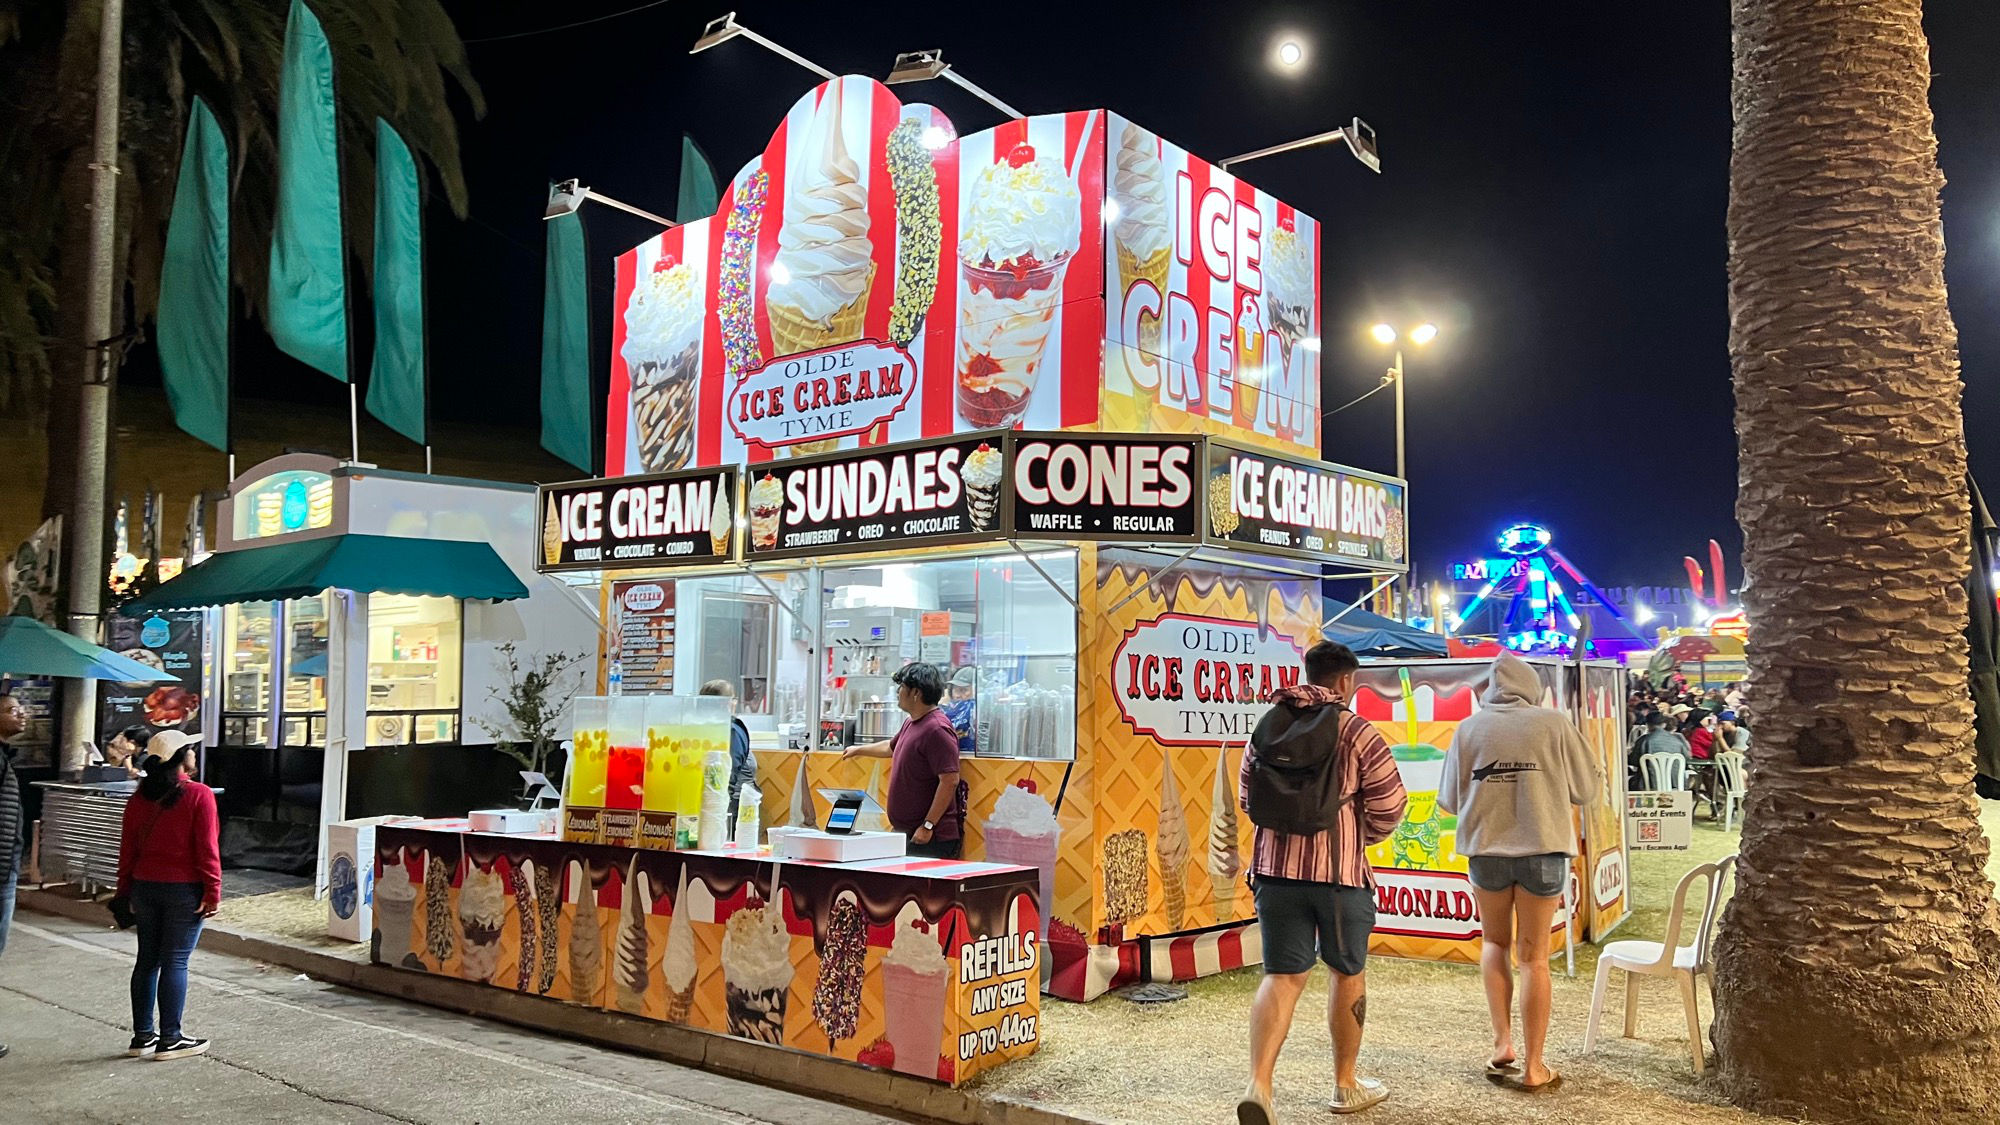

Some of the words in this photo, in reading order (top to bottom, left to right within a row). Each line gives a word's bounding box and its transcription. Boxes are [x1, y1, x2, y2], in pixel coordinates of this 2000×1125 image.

[1175, 169, 1262, 296] ICE
[785, 350, 854, 379] OLDE
[739, 386, 784, 422] ICE
[793, 363, 904, 414] CREAM
[780, 410, 853, 437] TYME
[784, 447, 961, 526] SUNDAES
[1014, 442, 1192, 508] CONES
[561, 491, 603, 543] ICE
[609, 480, 711, 539] CREAM
[1229, 455, 1265, 520] ICE
[1268, 465, 1337, 531] CREAM
[1341, 480, 1387, 539] BARS
[784, 528, 840, 548] STRAWBERRY
[858, 524, 884, 540] OREO
[903, 515, 961, 536] CHOCOLATE
[1030, 513, 1083, 530] WAFFLE
[1112, 515, 1175, 532] REGULAR
[574, 547, 602, 561] VANILLA
[613, 544, 656, 559] CHOCOLATE
[666, 541, 694, 556] COMBO
[1260, 528, 1291, 546] PEANUTS
[1305, 535, 1324, 551] OREO
[1338, 540, 1369, 557] SPRINKLES
[627, 593, 638, 603] ICE
[639, 591, 662, 602] CREAM
[1182, 626, 1256, 655] OLDE
[165, 661, 192, 669] Bacon
[1126, 653, 1183, 701] ICE
[1193, 658, 1300, 705] CREAM
[1179, 711, 1256, 735] TYME
[569, 817, 599, 831] LEMONADE
[602, 813, 637, 826] STRAWBERRY
[1649, 810, 1658, 818] of
[1660, 810, 1686, 818] Events
[604, 826, 634, 838] LEMONADE
[643, 821, 673, 837] LEMONADE
[1373, 885, 1480, 922] MONAD
[960, 930, 1036, 984] REFILLS
[971, 984, 999, 1015] ANY
[1000, 978, 1027, 1008] SIZE
[960, 1032, 978, 1060] UP
[979, 1027, 998, 1055] TO
